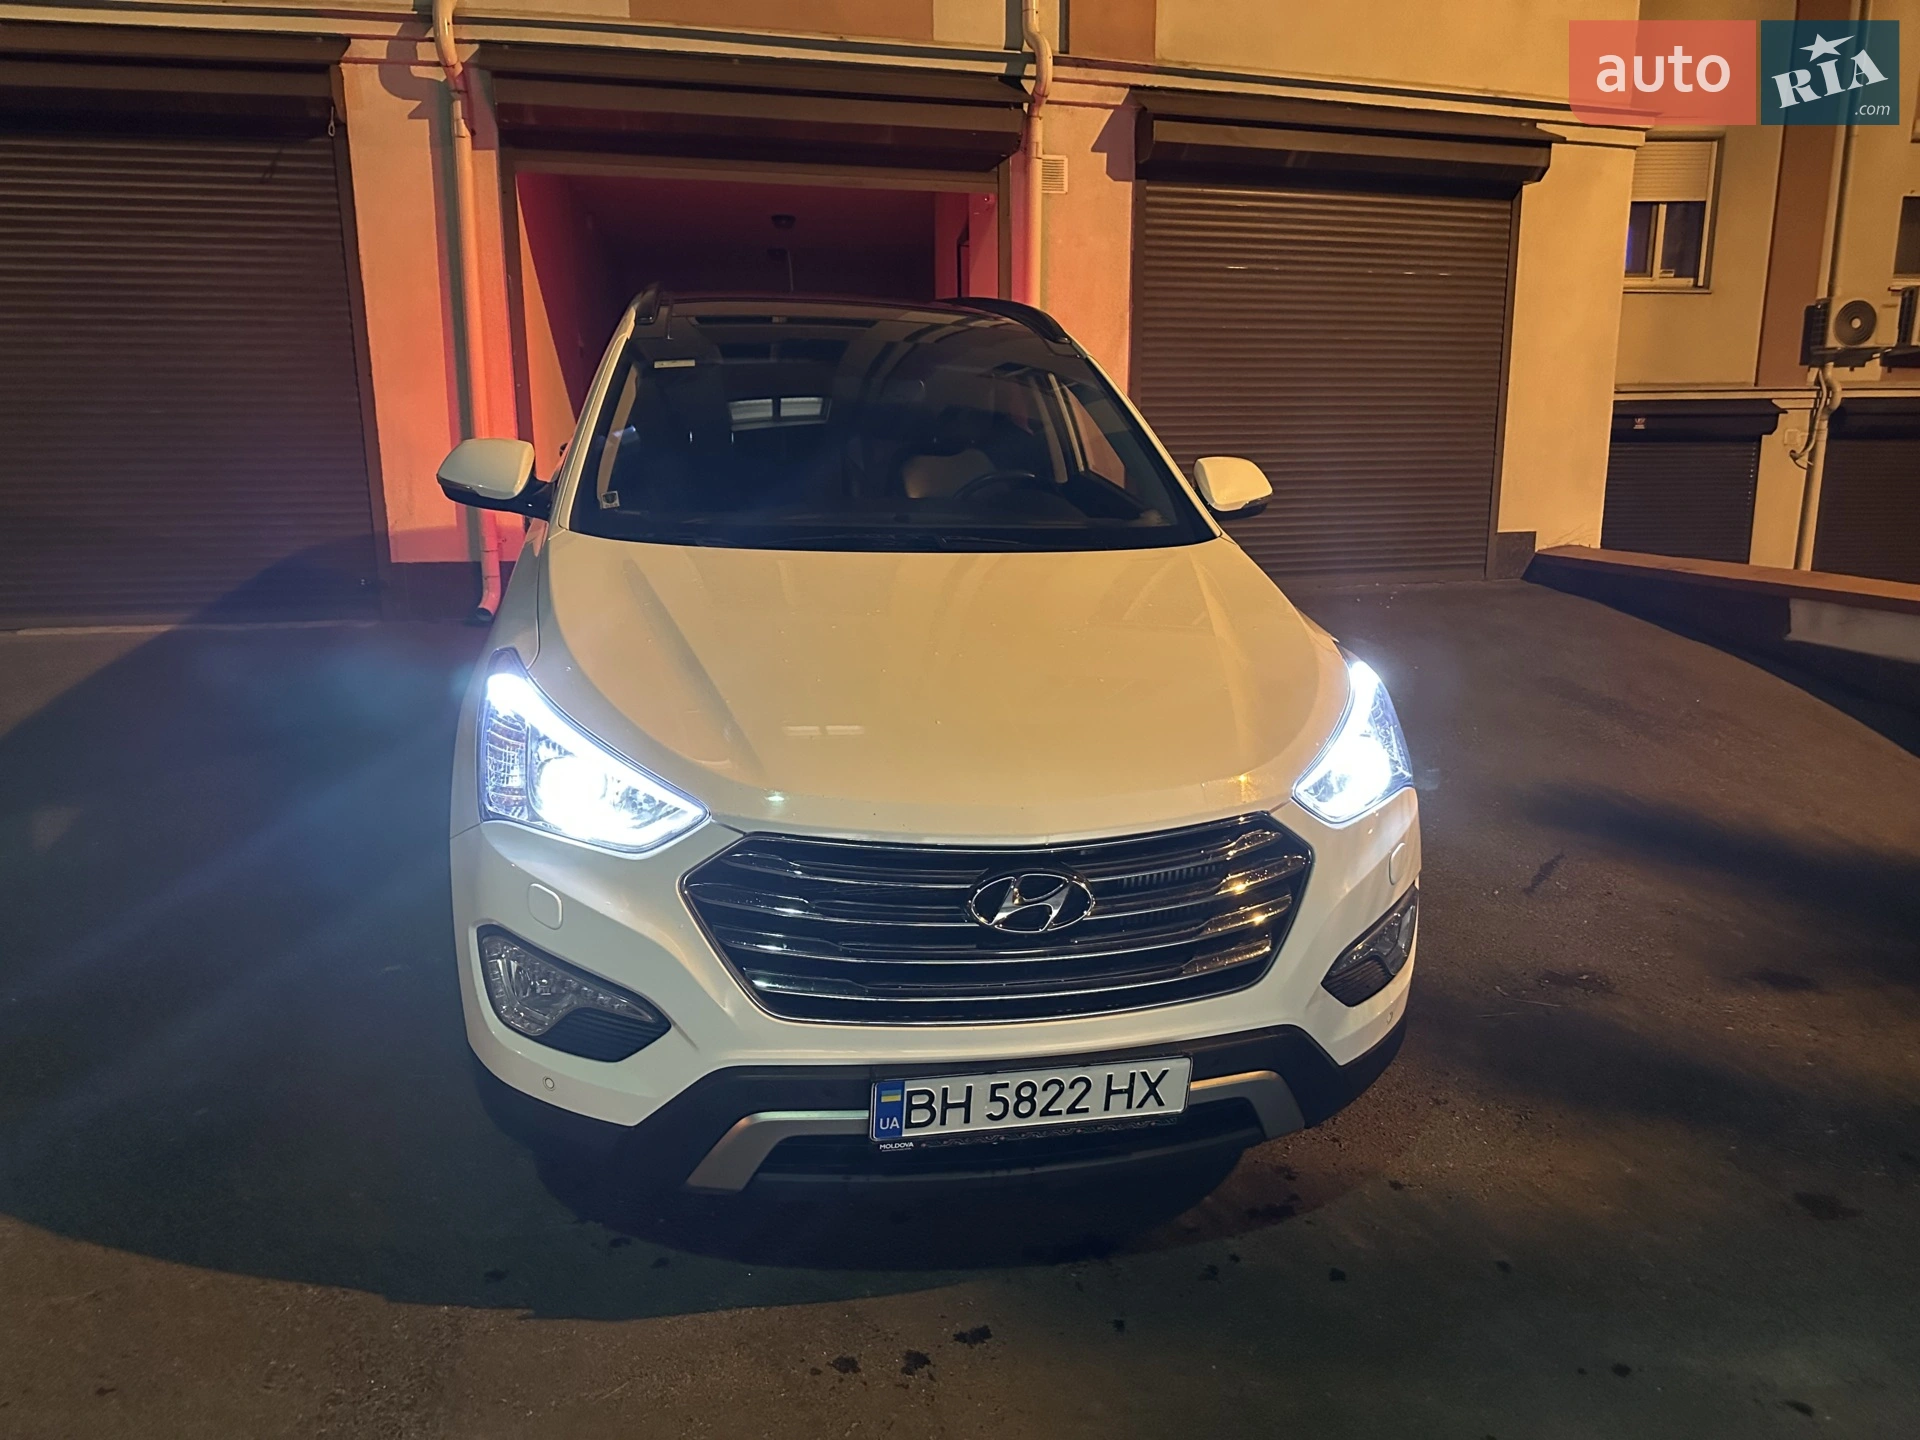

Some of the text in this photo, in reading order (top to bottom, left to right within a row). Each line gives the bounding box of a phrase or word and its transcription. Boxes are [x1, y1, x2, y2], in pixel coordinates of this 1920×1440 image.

[904, 1068, 1170, 1129] BH 5822 HX
[879, 1117, 900, 1130] UA
[879, 1141, 914, 1150] MOLDOVA
